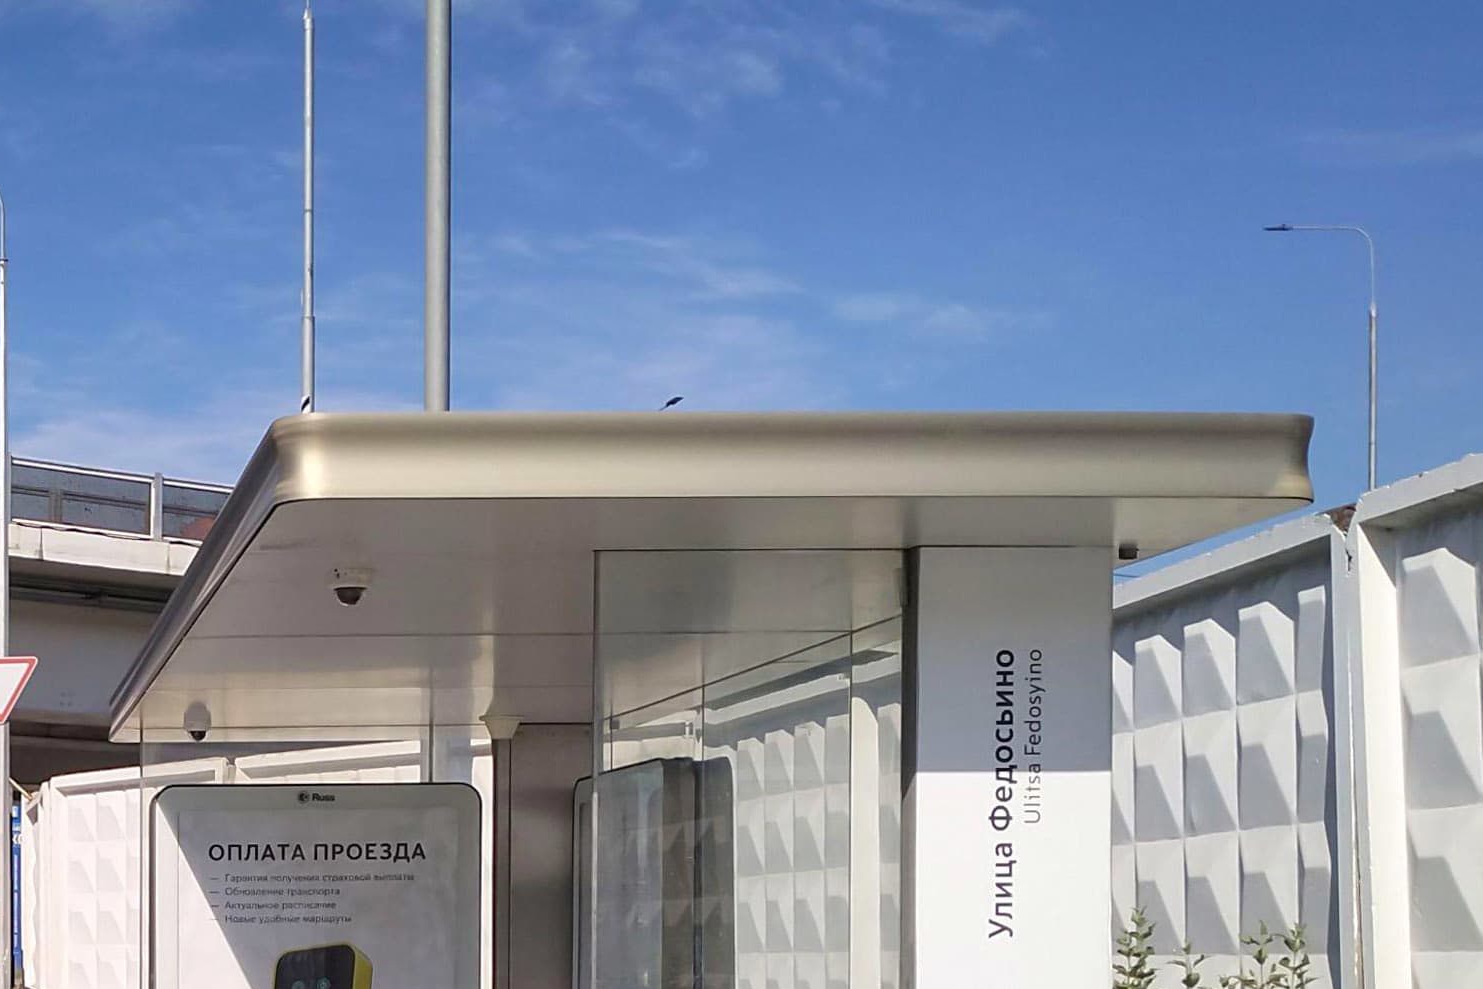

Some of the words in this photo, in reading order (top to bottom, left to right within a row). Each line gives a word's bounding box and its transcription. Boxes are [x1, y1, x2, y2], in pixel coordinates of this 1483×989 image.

[988, 649, 1017, 831] Федосьино
[1024, 649, 1046, 756] Fedosyino
[1024, 762, 1041, 824] Ulitsa
[208, 843, 306, 861] ОПЛАТА
[313, 842, 426, 863] ПРОЕЗДА
[988, 842, 1017, 938] Улица
